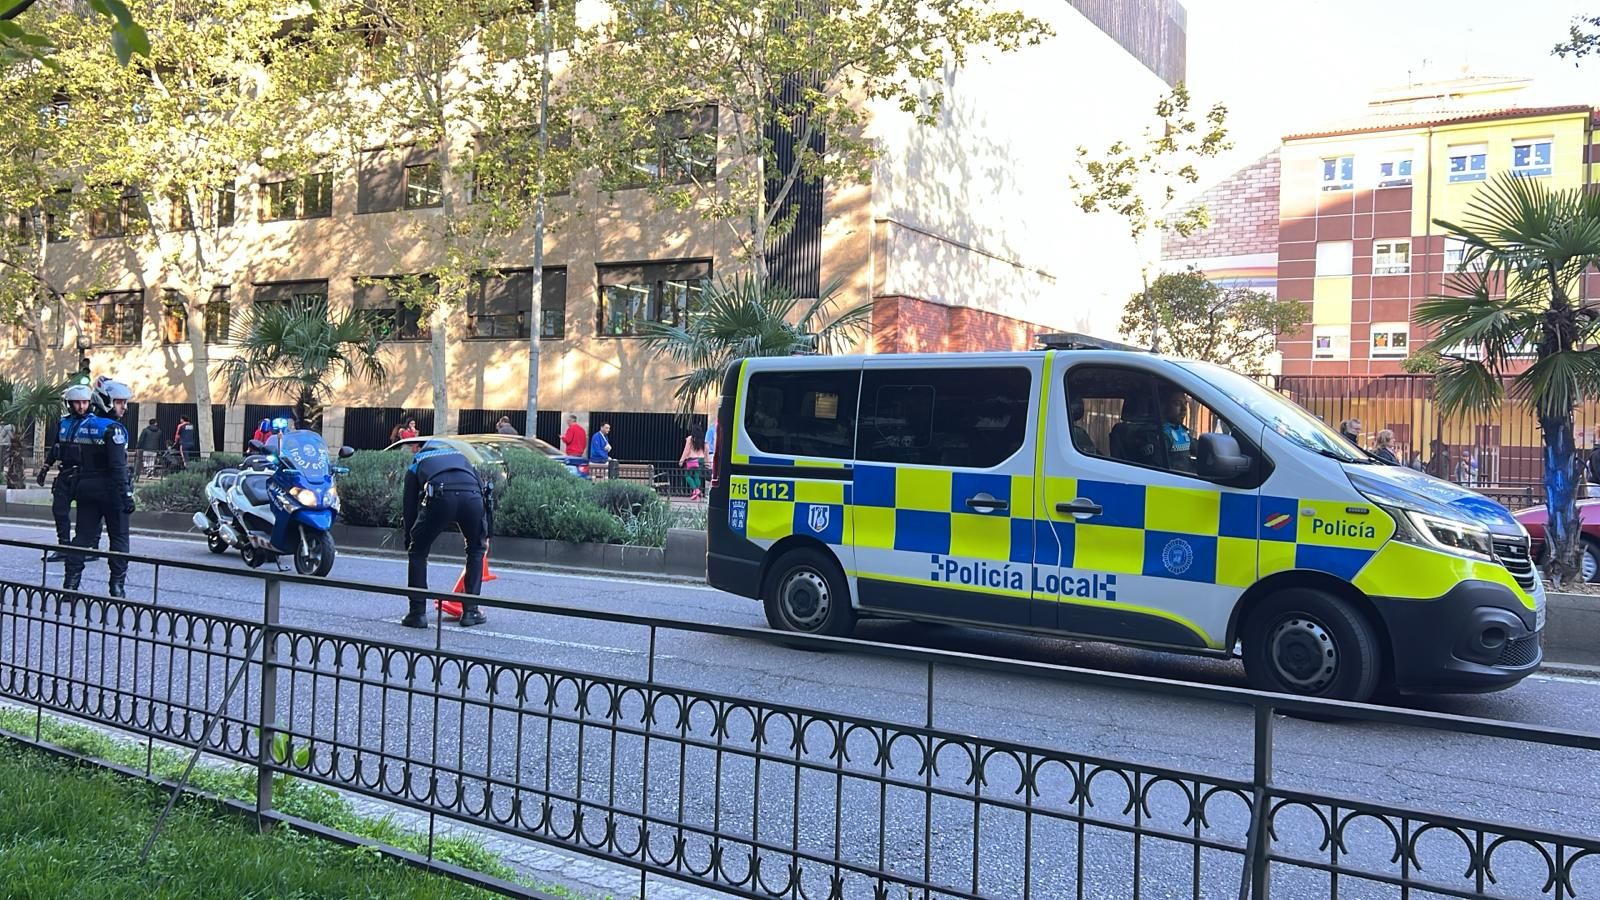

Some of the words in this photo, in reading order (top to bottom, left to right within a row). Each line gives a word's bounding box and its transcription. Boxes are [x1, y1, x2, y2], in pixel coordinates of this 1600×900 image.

[79, 427, 99, 435] POLCIA
[731, 483, 748, 494] 715
[1312, 518, 1375, 538] Policía
[945, 559, 1023, 590] Policía
[1032, 567, 1098, 598] Local
